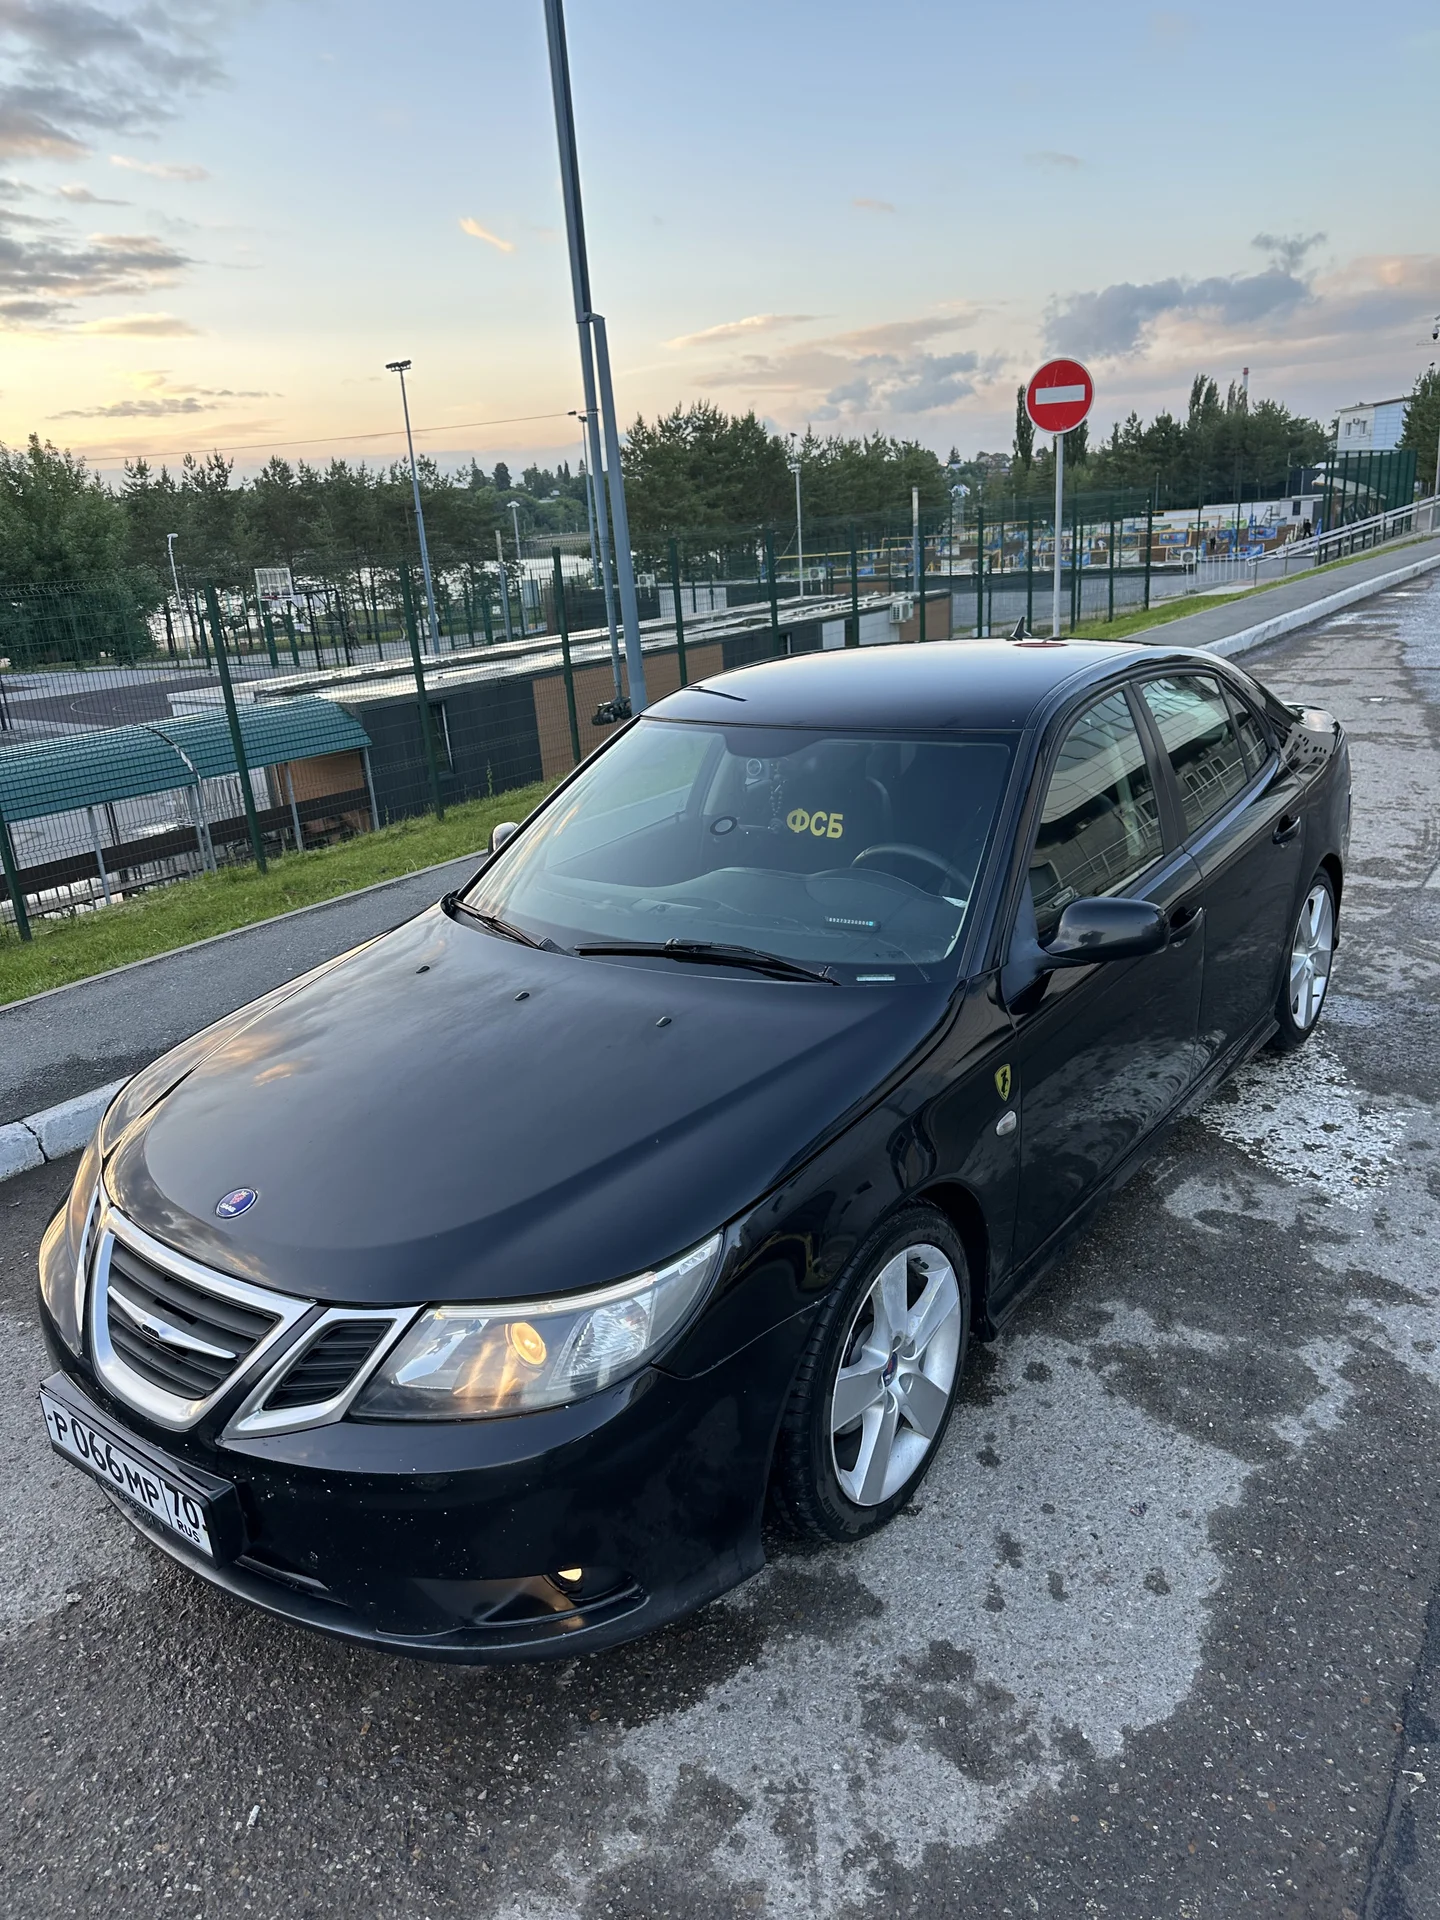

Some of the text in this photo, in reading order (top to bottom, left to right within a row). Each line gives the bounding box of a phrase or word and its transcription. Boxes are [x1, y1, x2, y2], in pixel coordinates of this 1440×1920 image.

[787, 808, 843, 838] ФСБ
[164, 1482, 200, 1529] 70
[176, 1519, 201, 1543] RUS
